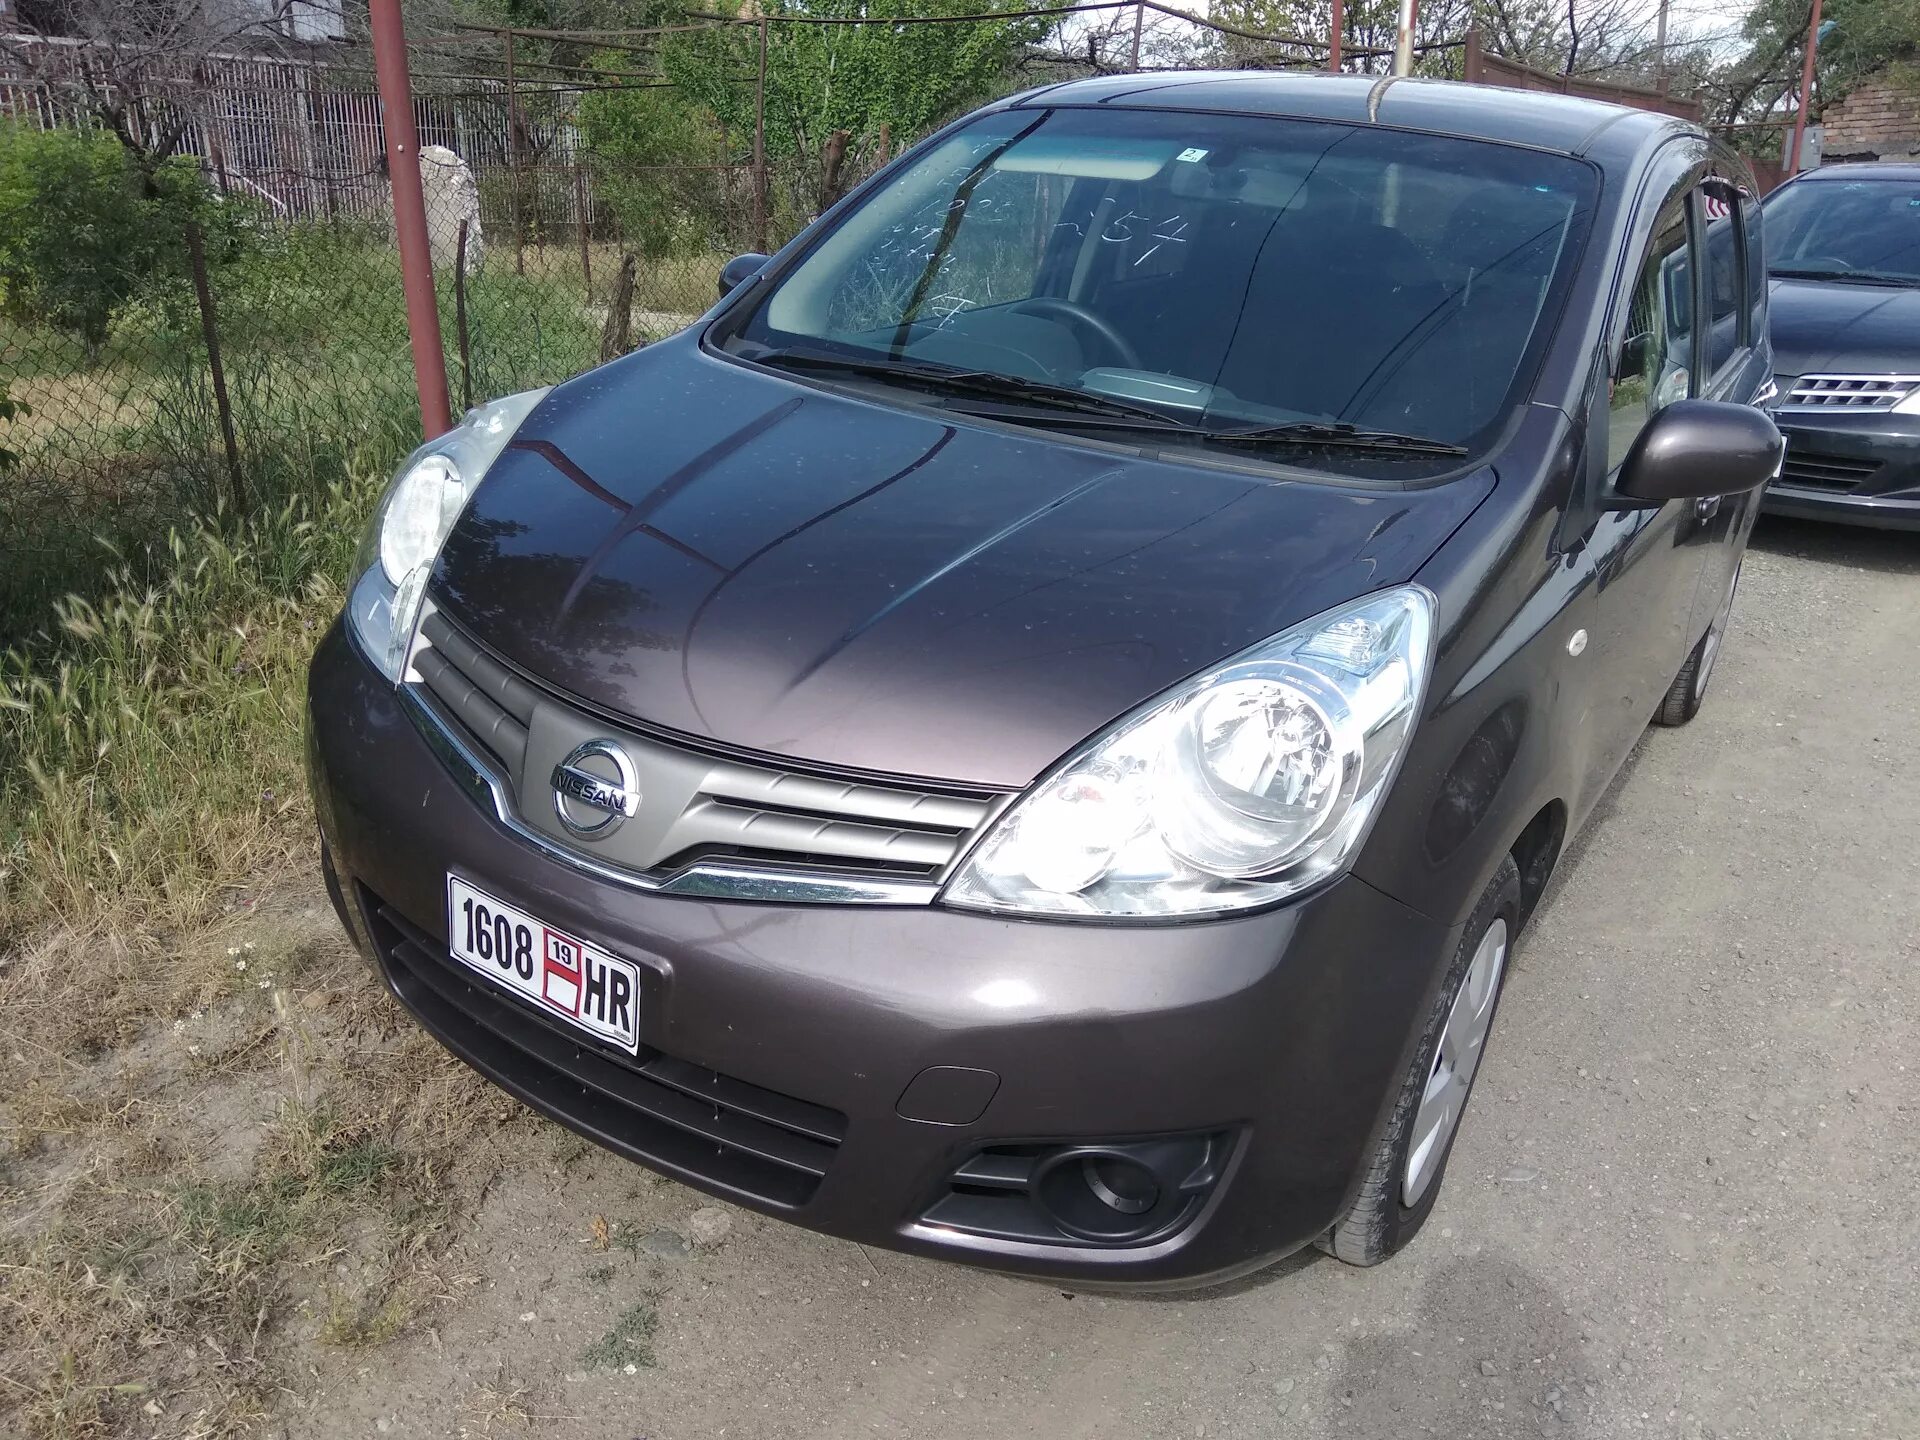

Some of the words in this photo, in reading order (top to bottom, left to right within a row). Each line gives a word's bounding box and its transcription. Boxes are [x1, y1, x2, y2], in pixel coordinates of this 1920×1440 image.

[557, 772, 627, 811] NISSAN
[463, 897, 534, 981] 1608
[553, 940, 572, 965] 19
[583, 957, 631, 1033] HR
